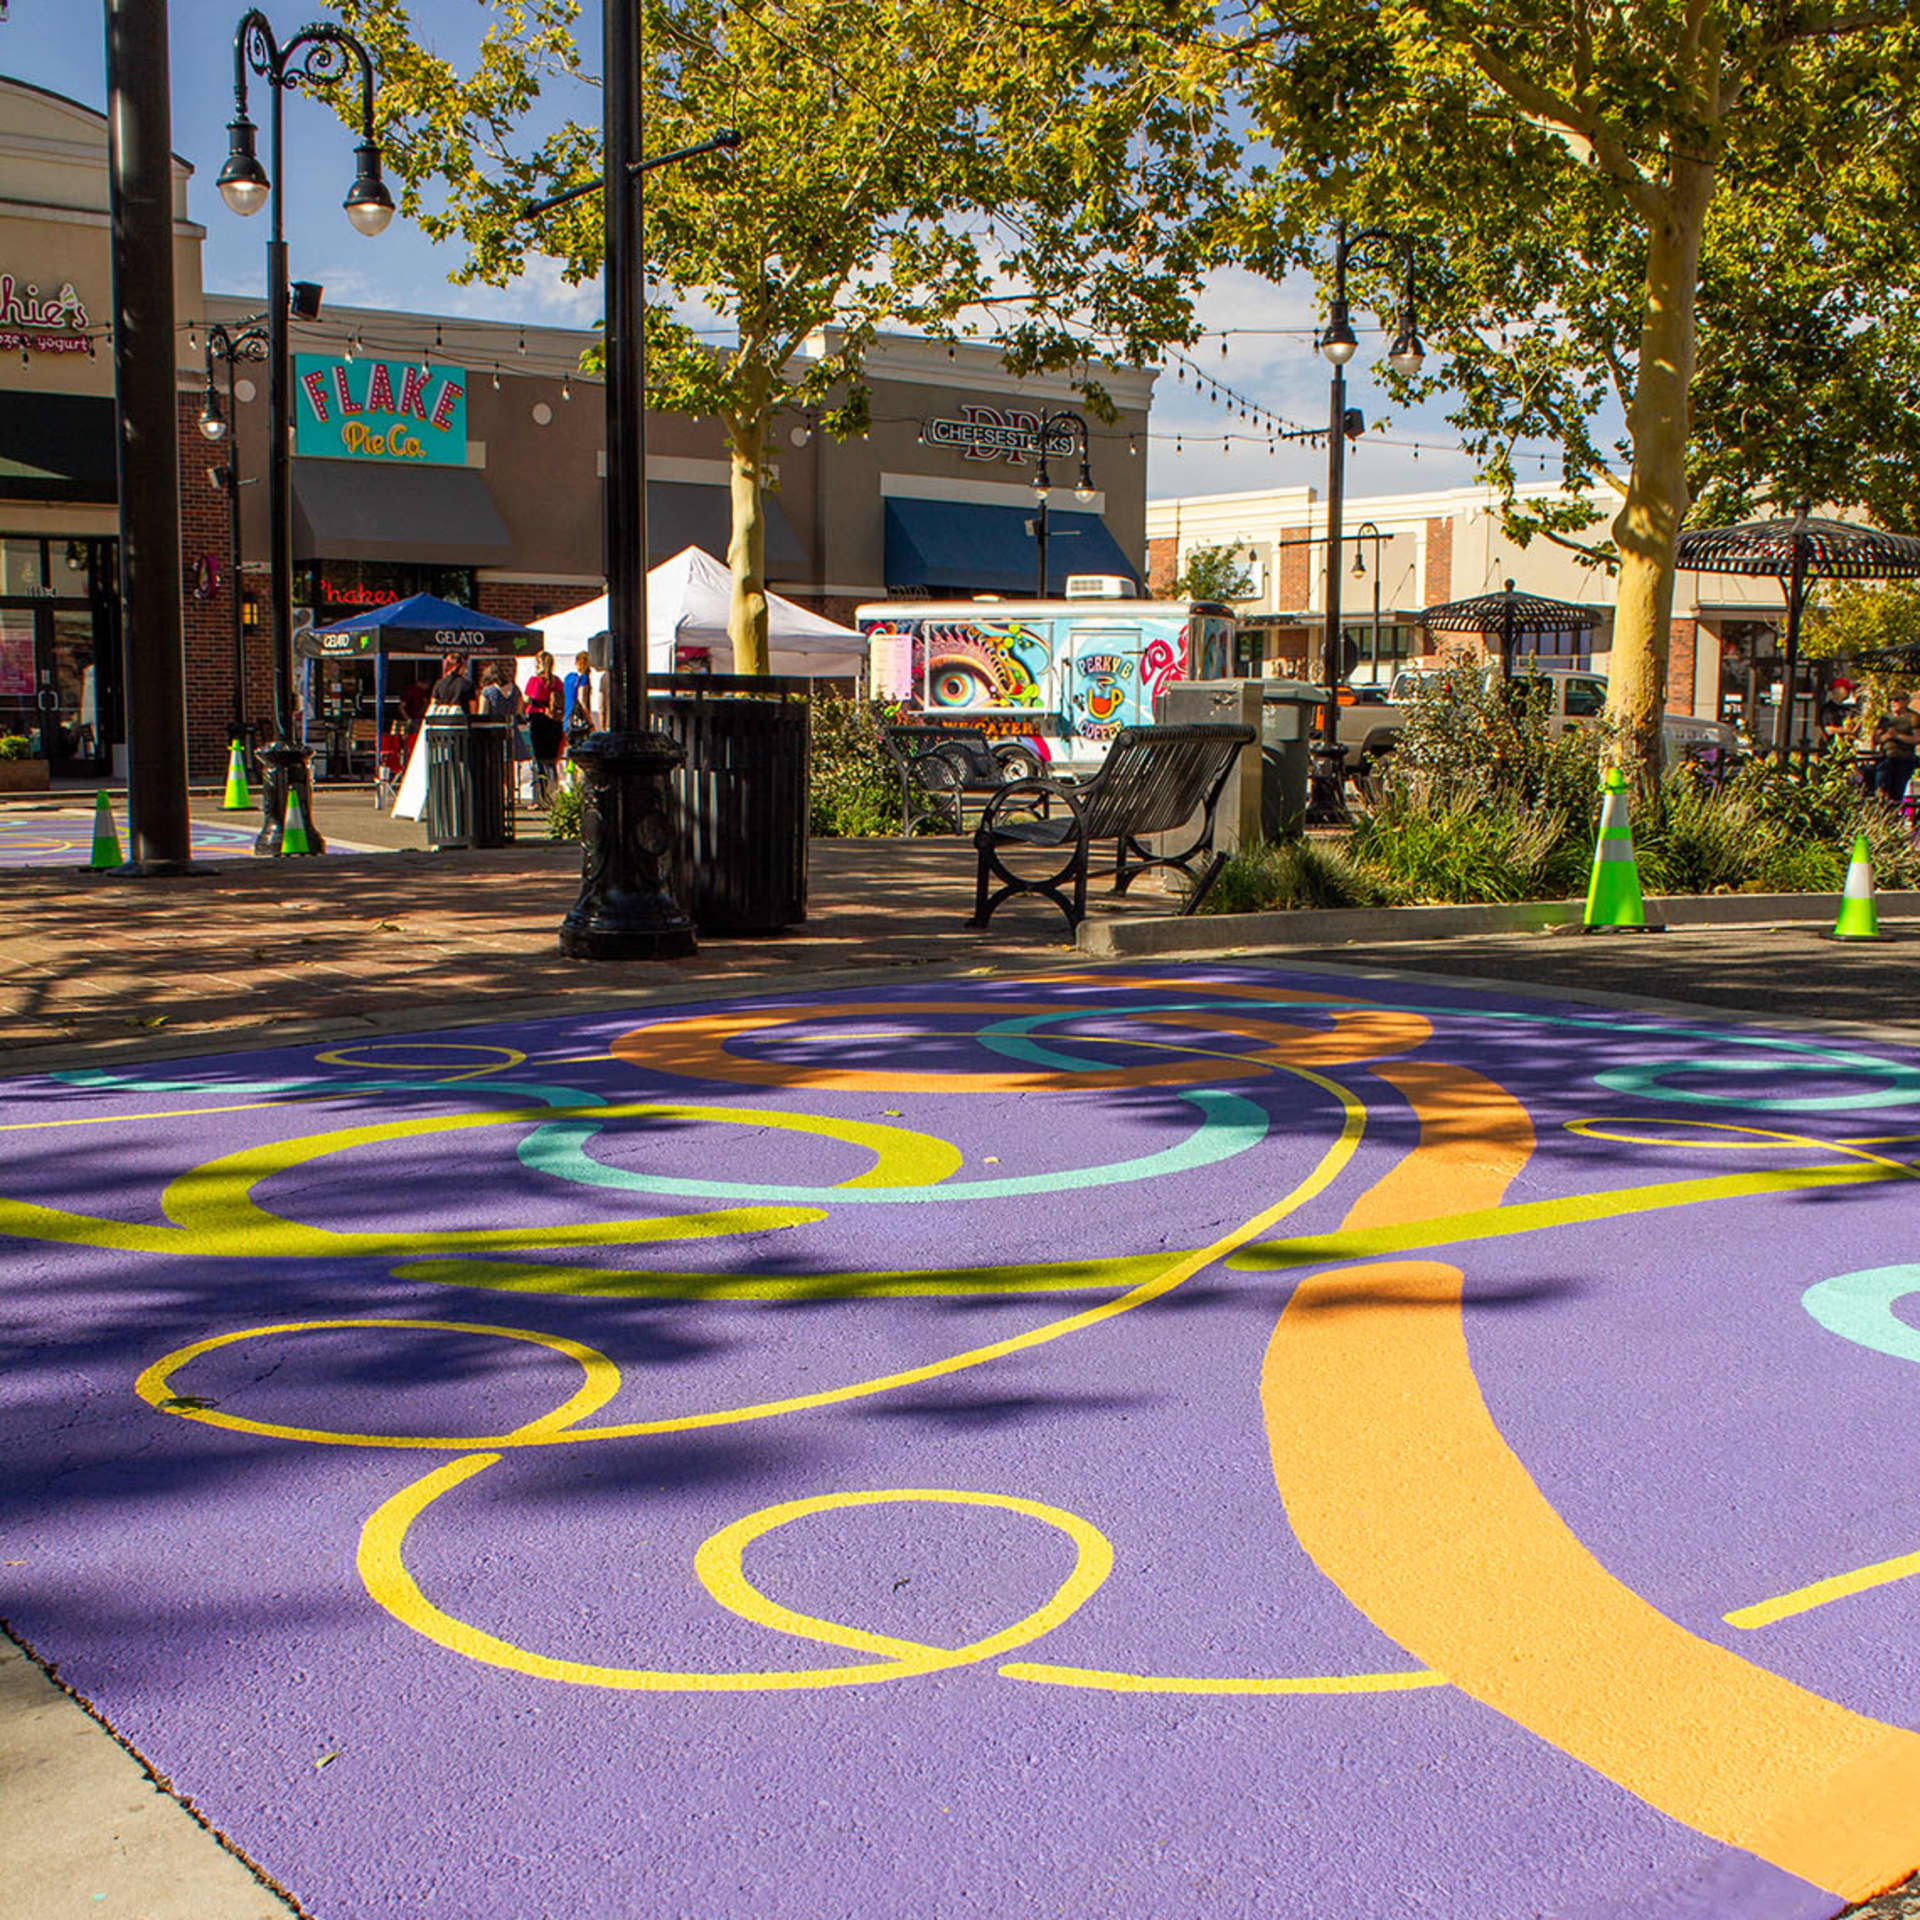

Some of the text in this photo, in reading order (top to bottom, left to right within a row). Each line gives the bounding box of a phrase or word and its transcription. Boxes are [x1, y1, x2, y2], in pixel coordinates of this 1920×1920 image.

[36, 334, 89, 353] yogurt
[300, 363, 464, 433] FLAKE
[341, 420, 427, 457] Pie Co.
[320, 578, 399, 605] hakes
[435, 629, 485, 646] GELATO
[1078, 655, 1133, 680] PERKY B
